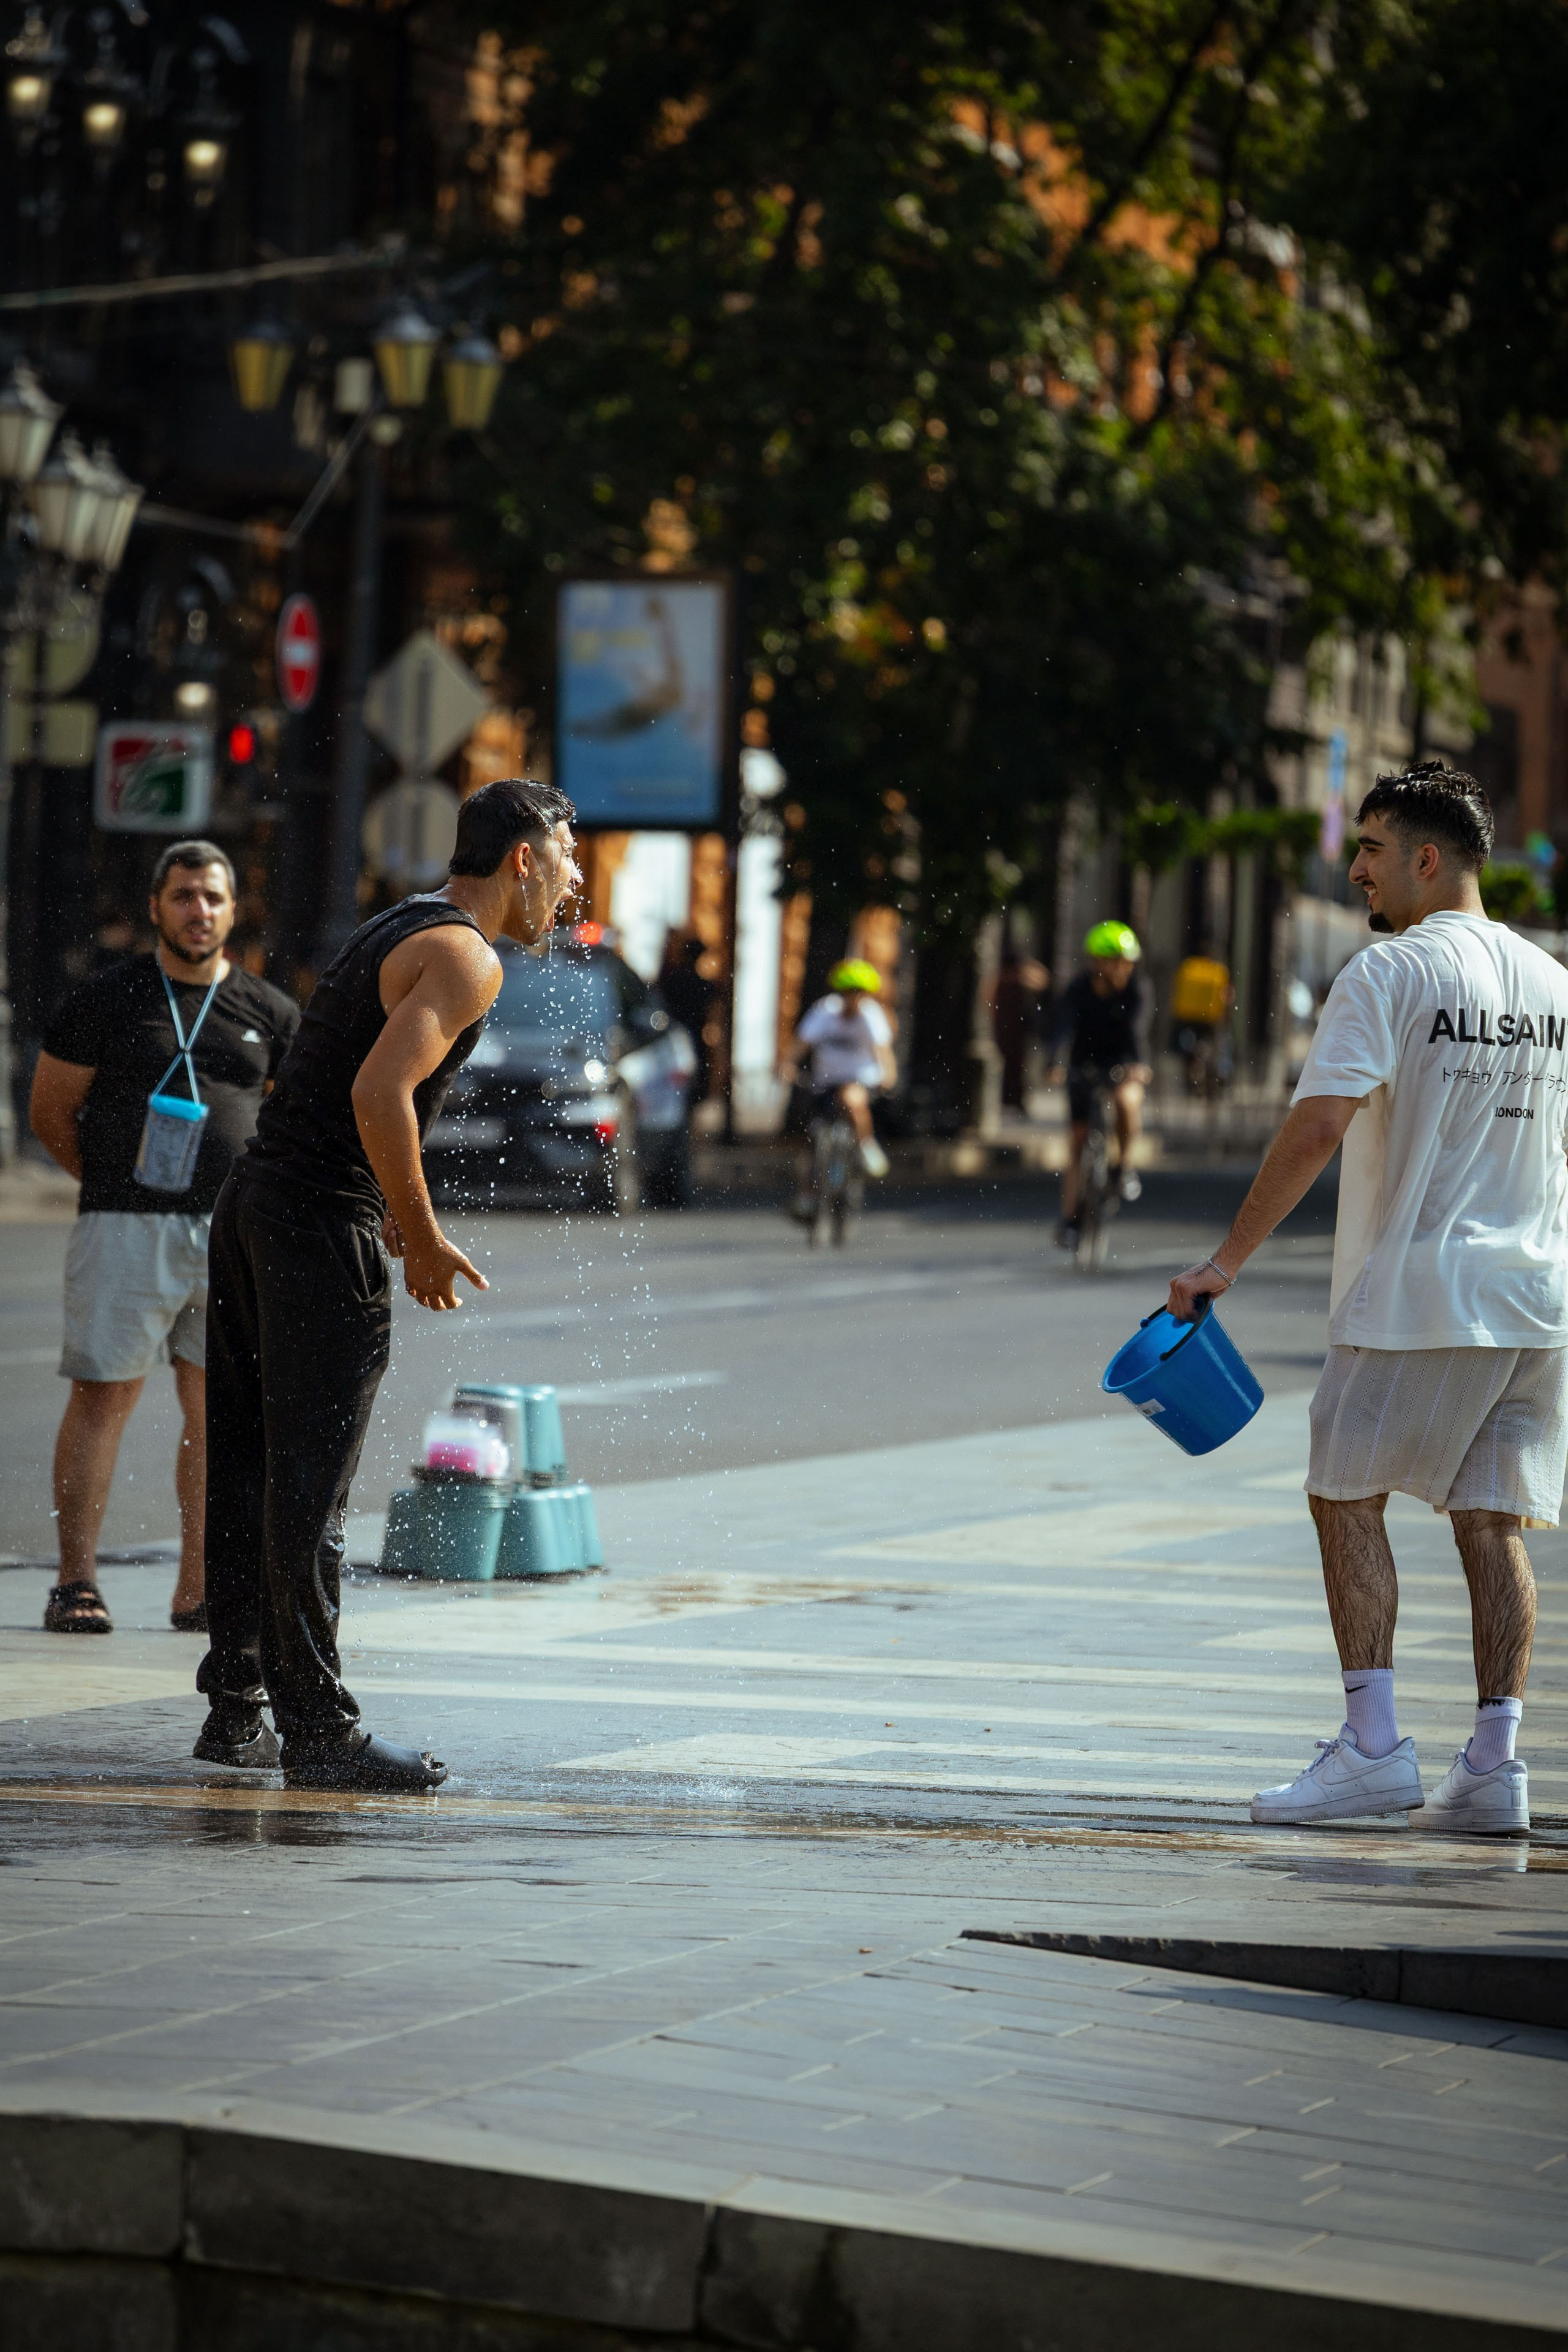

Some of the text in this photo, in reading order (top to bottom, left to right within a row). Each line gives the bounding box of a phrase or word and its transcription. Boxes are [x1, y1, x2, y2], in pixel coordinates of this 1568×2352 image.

[1428, 1008, 1568, 1051] ALLSAIN
[1443, 1067, 1491, 1085] トウキョウ
[1495, 1107, 1534, 1119] LONDON
